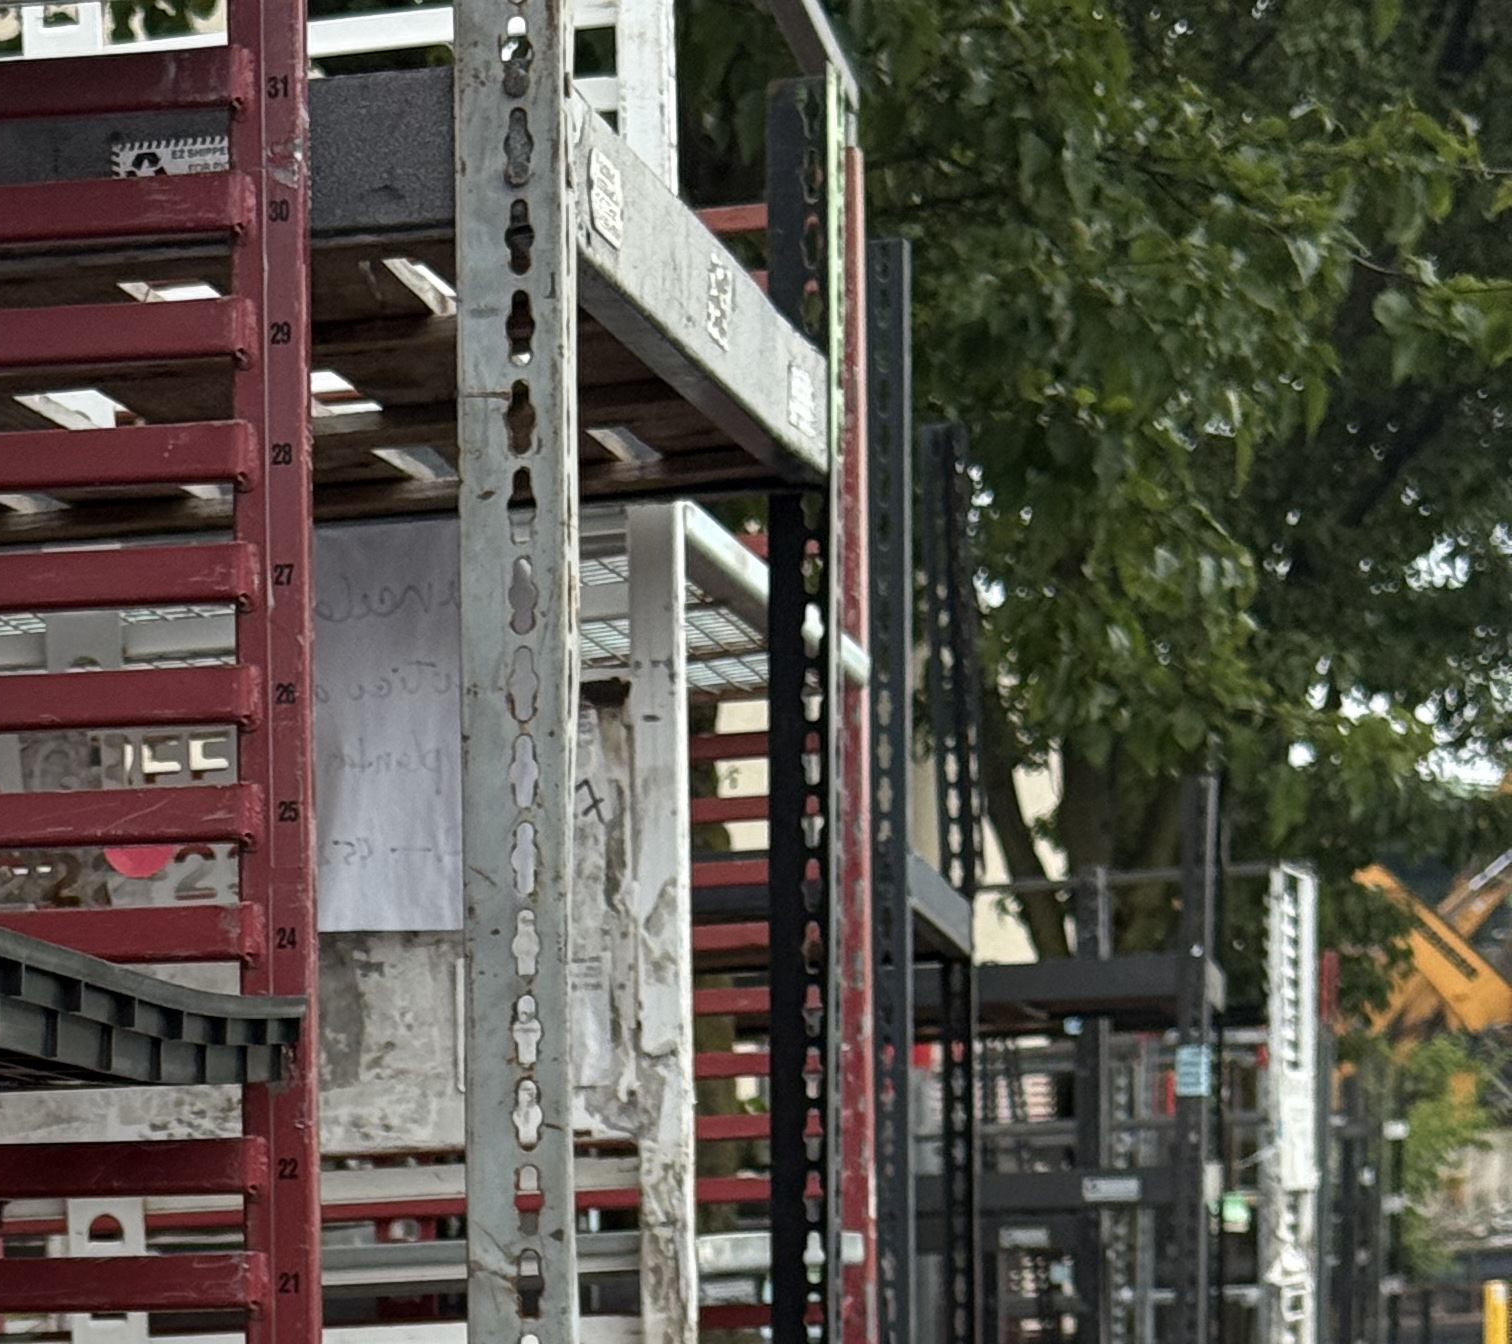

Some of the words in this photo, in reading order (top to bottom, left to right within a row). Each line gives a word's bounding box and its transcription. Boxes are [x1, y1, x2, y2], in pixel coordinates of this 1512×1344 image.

[267, 76, 288, 98] 31
[269, 200, 289, 222] 30
[271, 322, 291, 344] 29
[272, 443, 292, 465] 28
[274, 564, 294, 585] 27
[276, 683, 295, 704] 26
[278, 801, 298, 822] 25
[277, 928, 296, 949] 24
[279, 1158, 297, 1179] 22
[279, 1273, 299, 1293] 21
